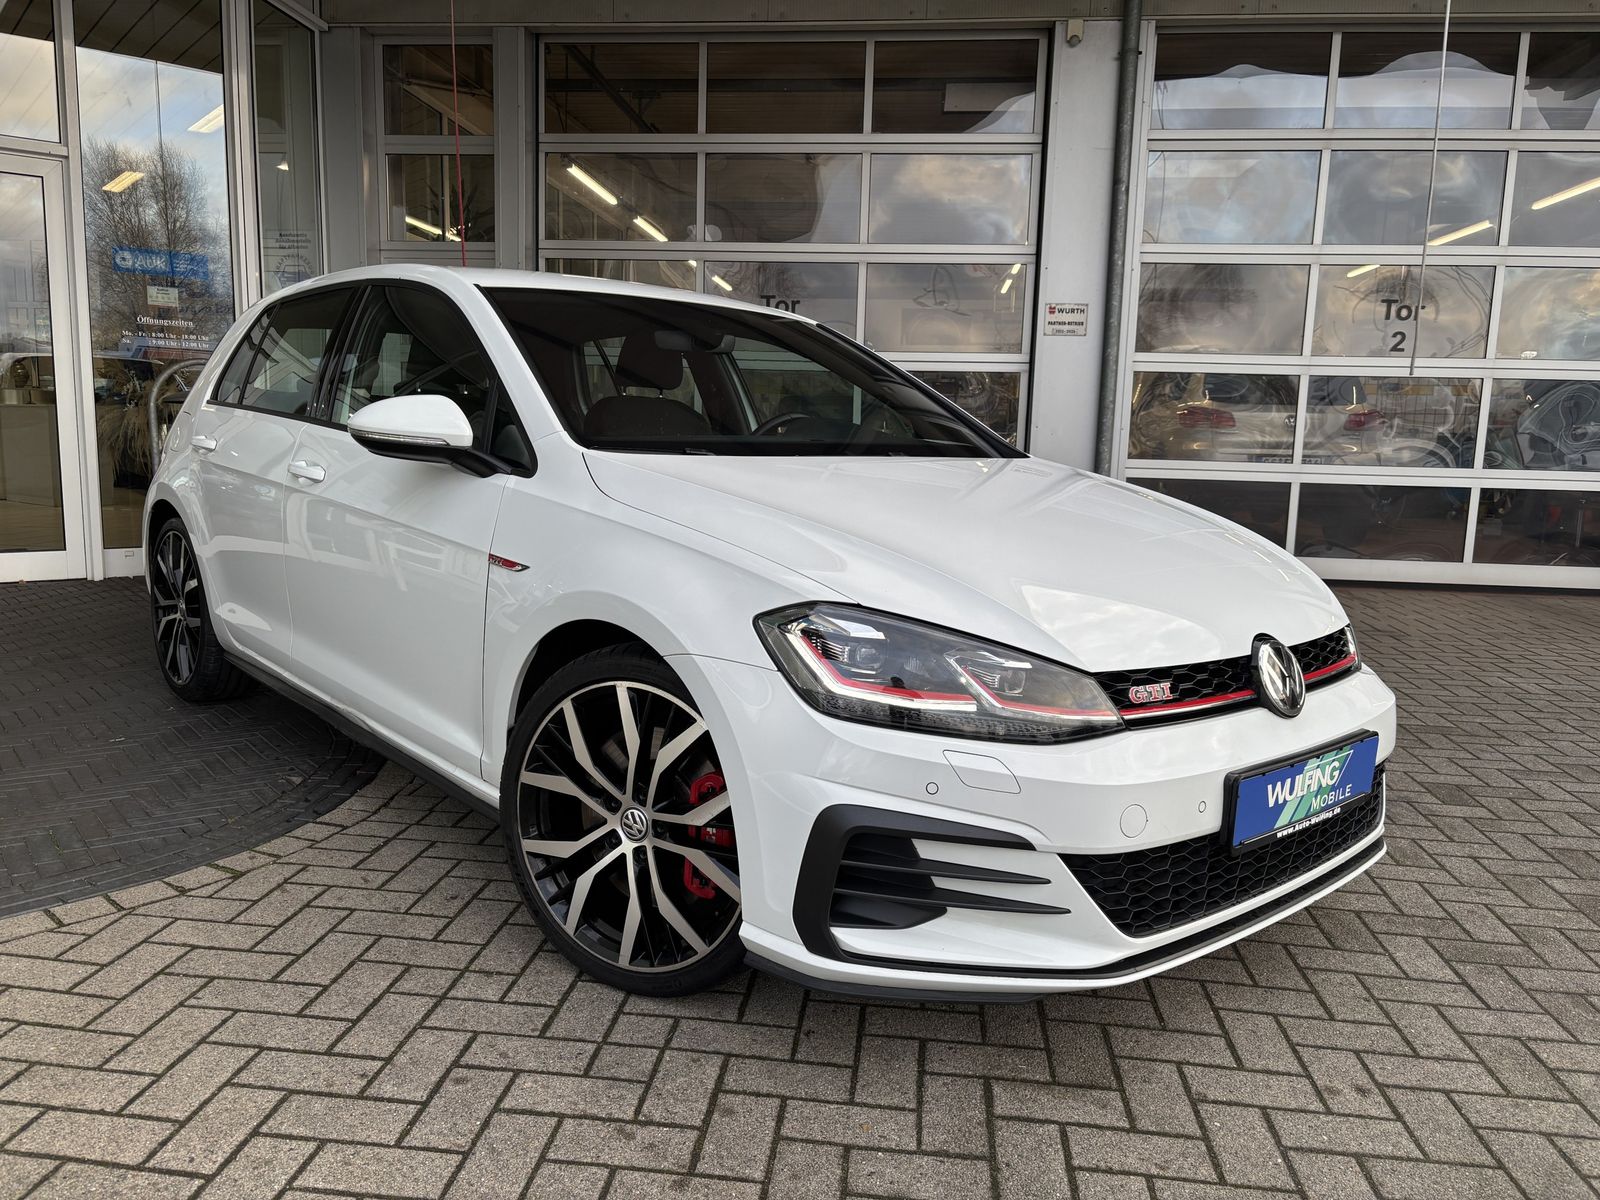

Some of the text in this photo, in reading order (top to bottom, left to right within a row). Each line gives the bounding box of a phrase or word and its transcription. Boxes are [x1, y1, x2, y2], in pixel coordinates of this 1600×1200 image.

[760, 295, 801, 314] Tor
[1381, 299, 1426, 321] Tor
[137, 314, 194, 327] Öffnungszeiten
[1389, 331, 1406, 352] 2
[1129, 682, 1173, 704] GTI
[1267, 760, 1340, 808] WULFING
[1310, 783, 1353, 812] MOBILE
